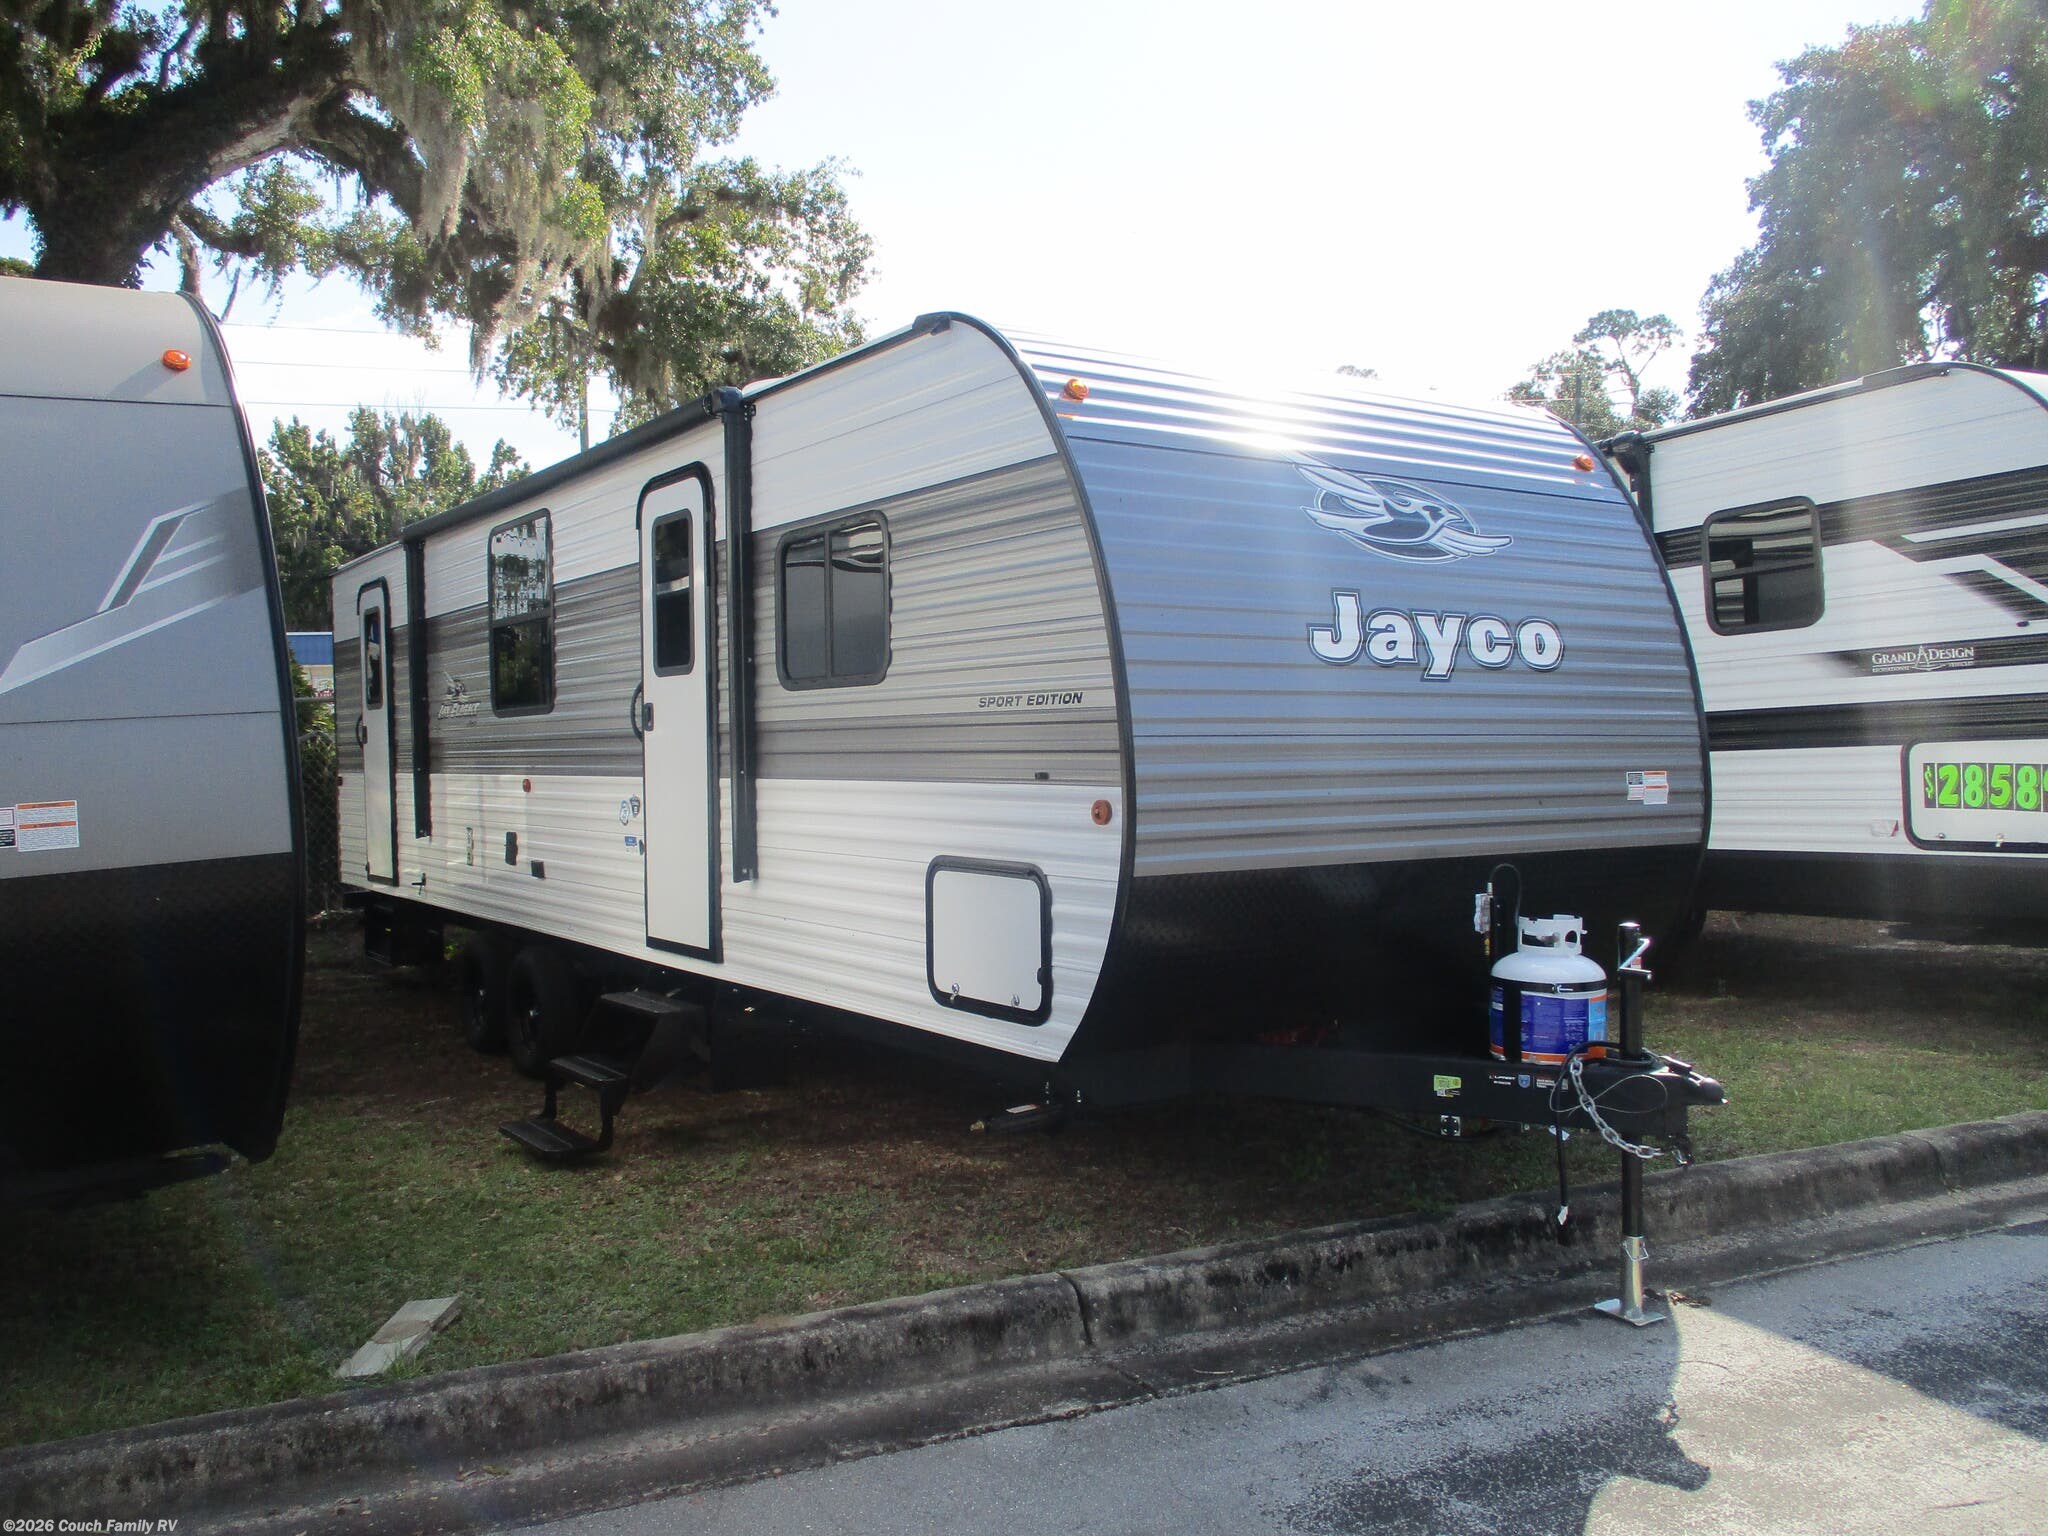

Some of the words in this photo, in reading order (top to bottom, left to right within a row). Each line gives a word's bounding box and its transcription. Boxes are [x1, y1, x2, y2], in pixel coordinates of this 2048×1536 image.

[1308, 590, 1565, 681] Jayco
[1872, 652, 1916, 664] GRAND
[1929, 647, 1974, 661] DESIGN
[978, 695, 1023, 708] SPORT
[1026, 691, 1083, 706] EDITION
[1924, 764, 2048, 810] $2858
